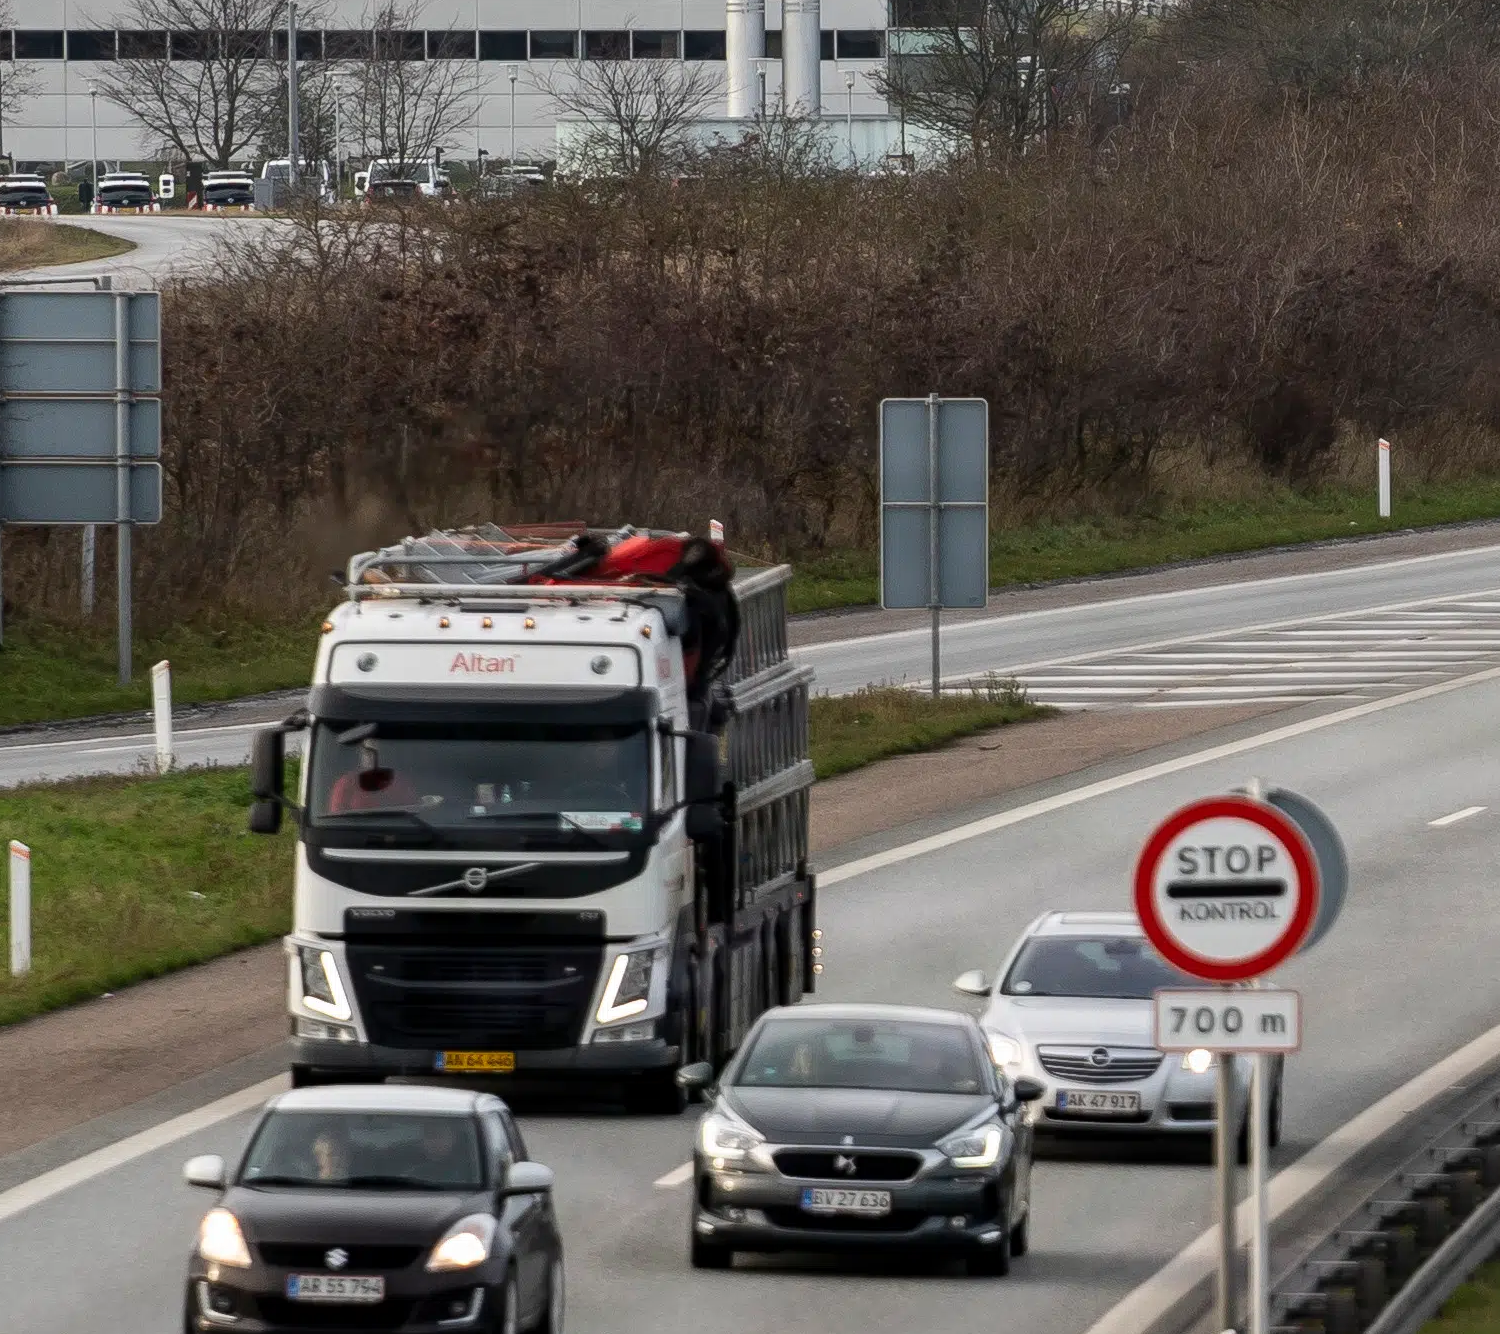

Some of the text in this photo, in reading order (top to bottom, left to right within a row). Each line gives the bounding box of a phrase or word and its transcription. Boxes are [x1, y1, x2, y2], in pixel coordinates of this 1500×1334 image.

[449, 652, 515, 673] Altan
[1177, 845, 1277, 875] STOP
[1180, 902, 1280, 921] KONTROL
[1169, 1005, 1286, 1034] 700 m
